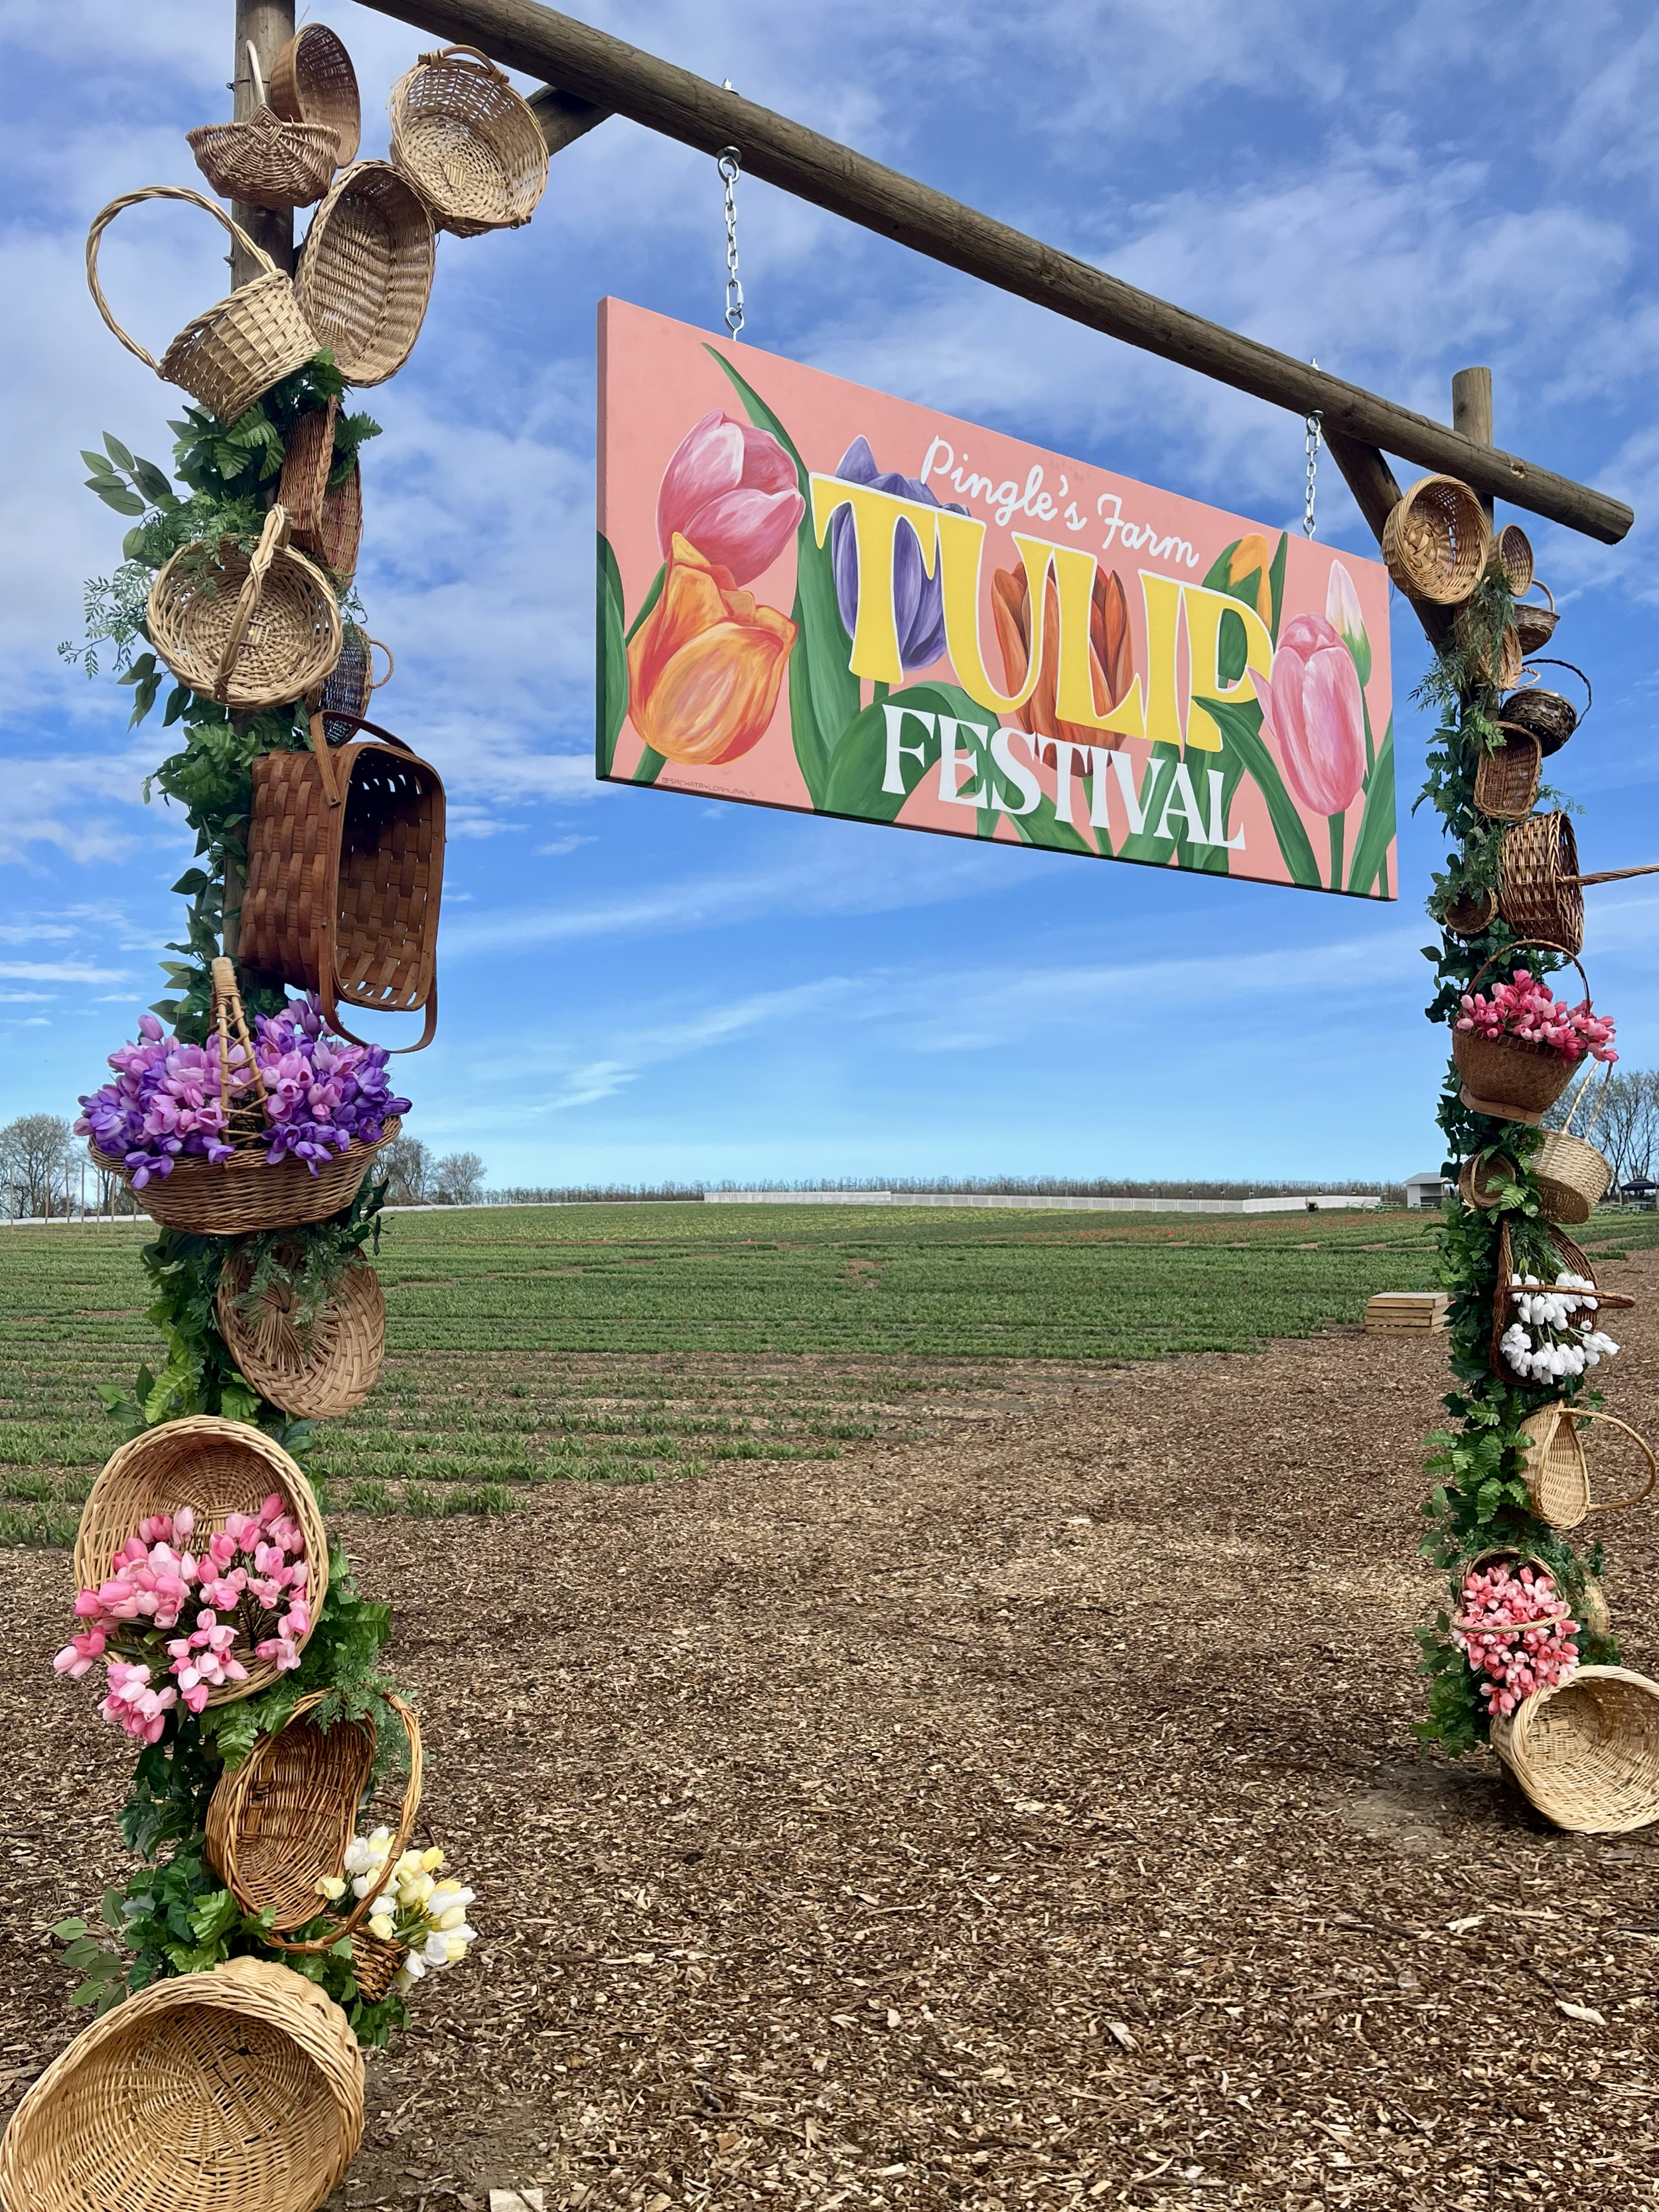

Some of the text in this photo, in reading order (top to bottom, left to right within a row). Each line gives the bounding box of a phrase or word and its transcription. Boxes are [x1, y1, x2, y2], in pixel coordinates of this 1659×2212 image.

[920, 435, 1198, 567] Pingle's Farm
[809, 472, 1274, 751] TULIP
[882, 704, 1246, 850] FESTIVAL
